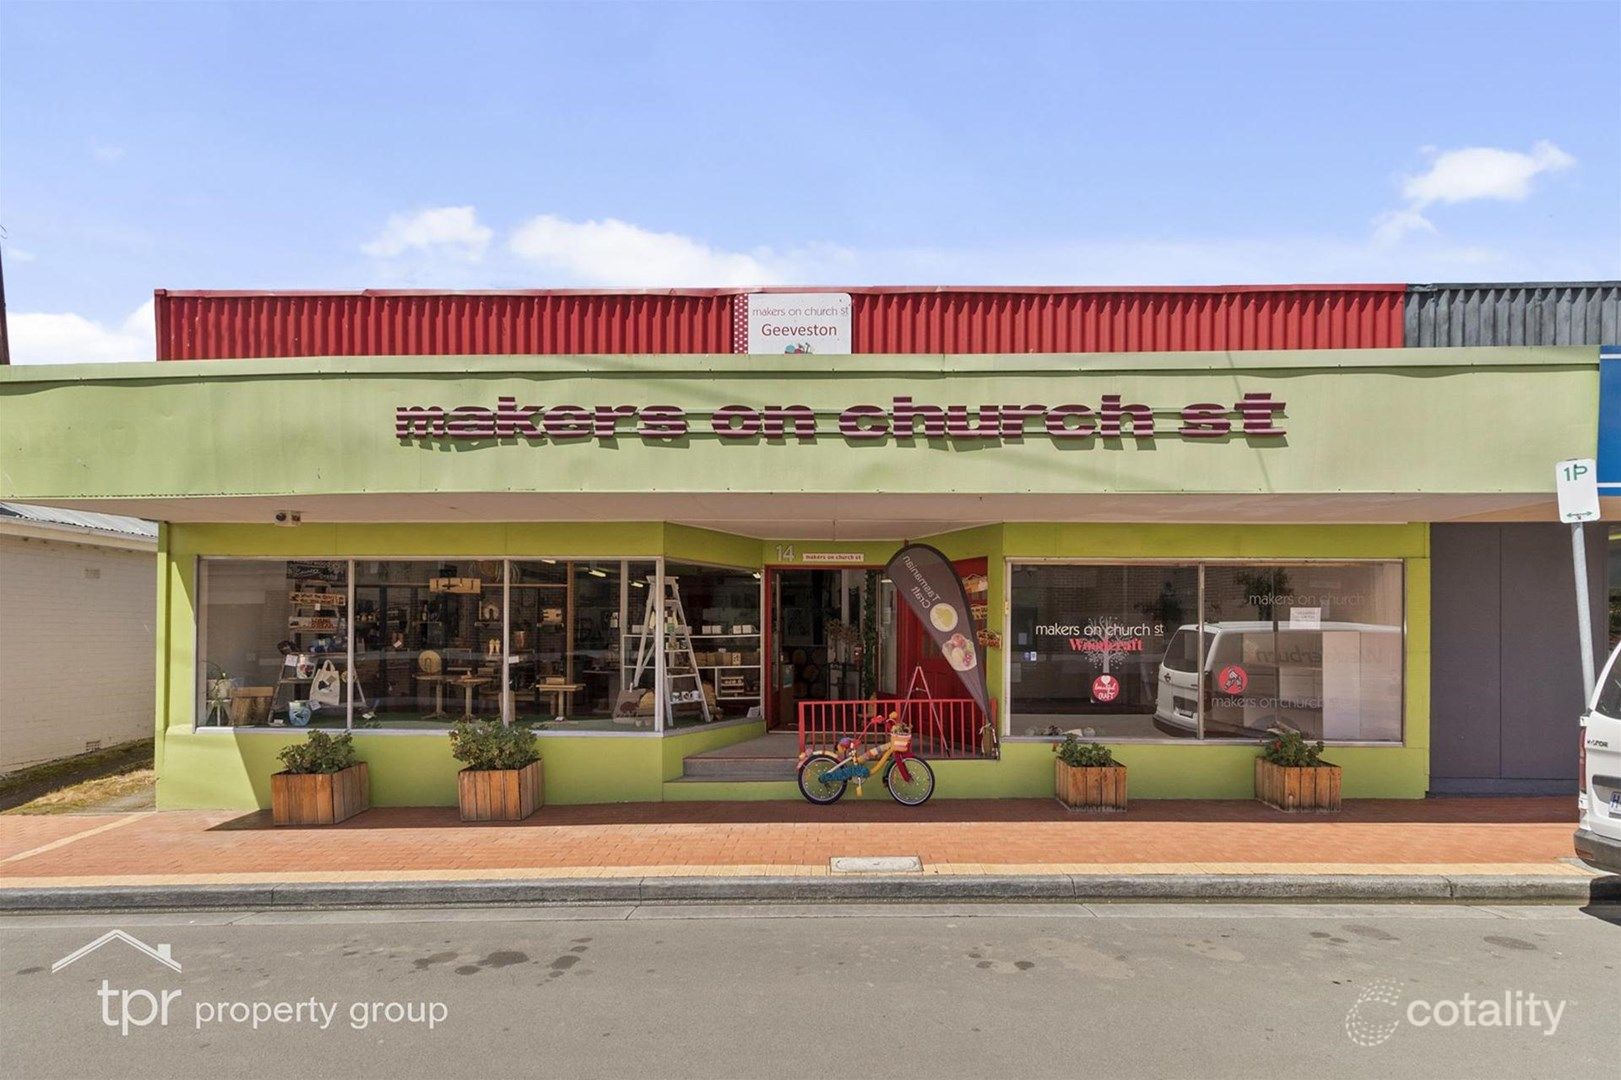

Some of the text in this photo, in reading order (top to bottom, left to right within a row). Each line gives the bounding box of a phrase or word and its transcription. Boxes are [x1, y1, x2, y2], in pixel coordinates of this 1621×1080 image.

[752, 306, 849, 317] makers on church st
[761, 323, 838, 337] Geeveston
[396, 392, 1287, 439] makers on church st
[1563, 464, 1588, 481] 1P
[776, 544, 795, 562] 14
[1250, 593, 1294, 605] makers
[1297, 594, 1316, 605] on
[1035, 622, 1164, 636] makers on church st
[1211, 696, 1257, 709] makers
[1259, 698, 1278, 708] on
